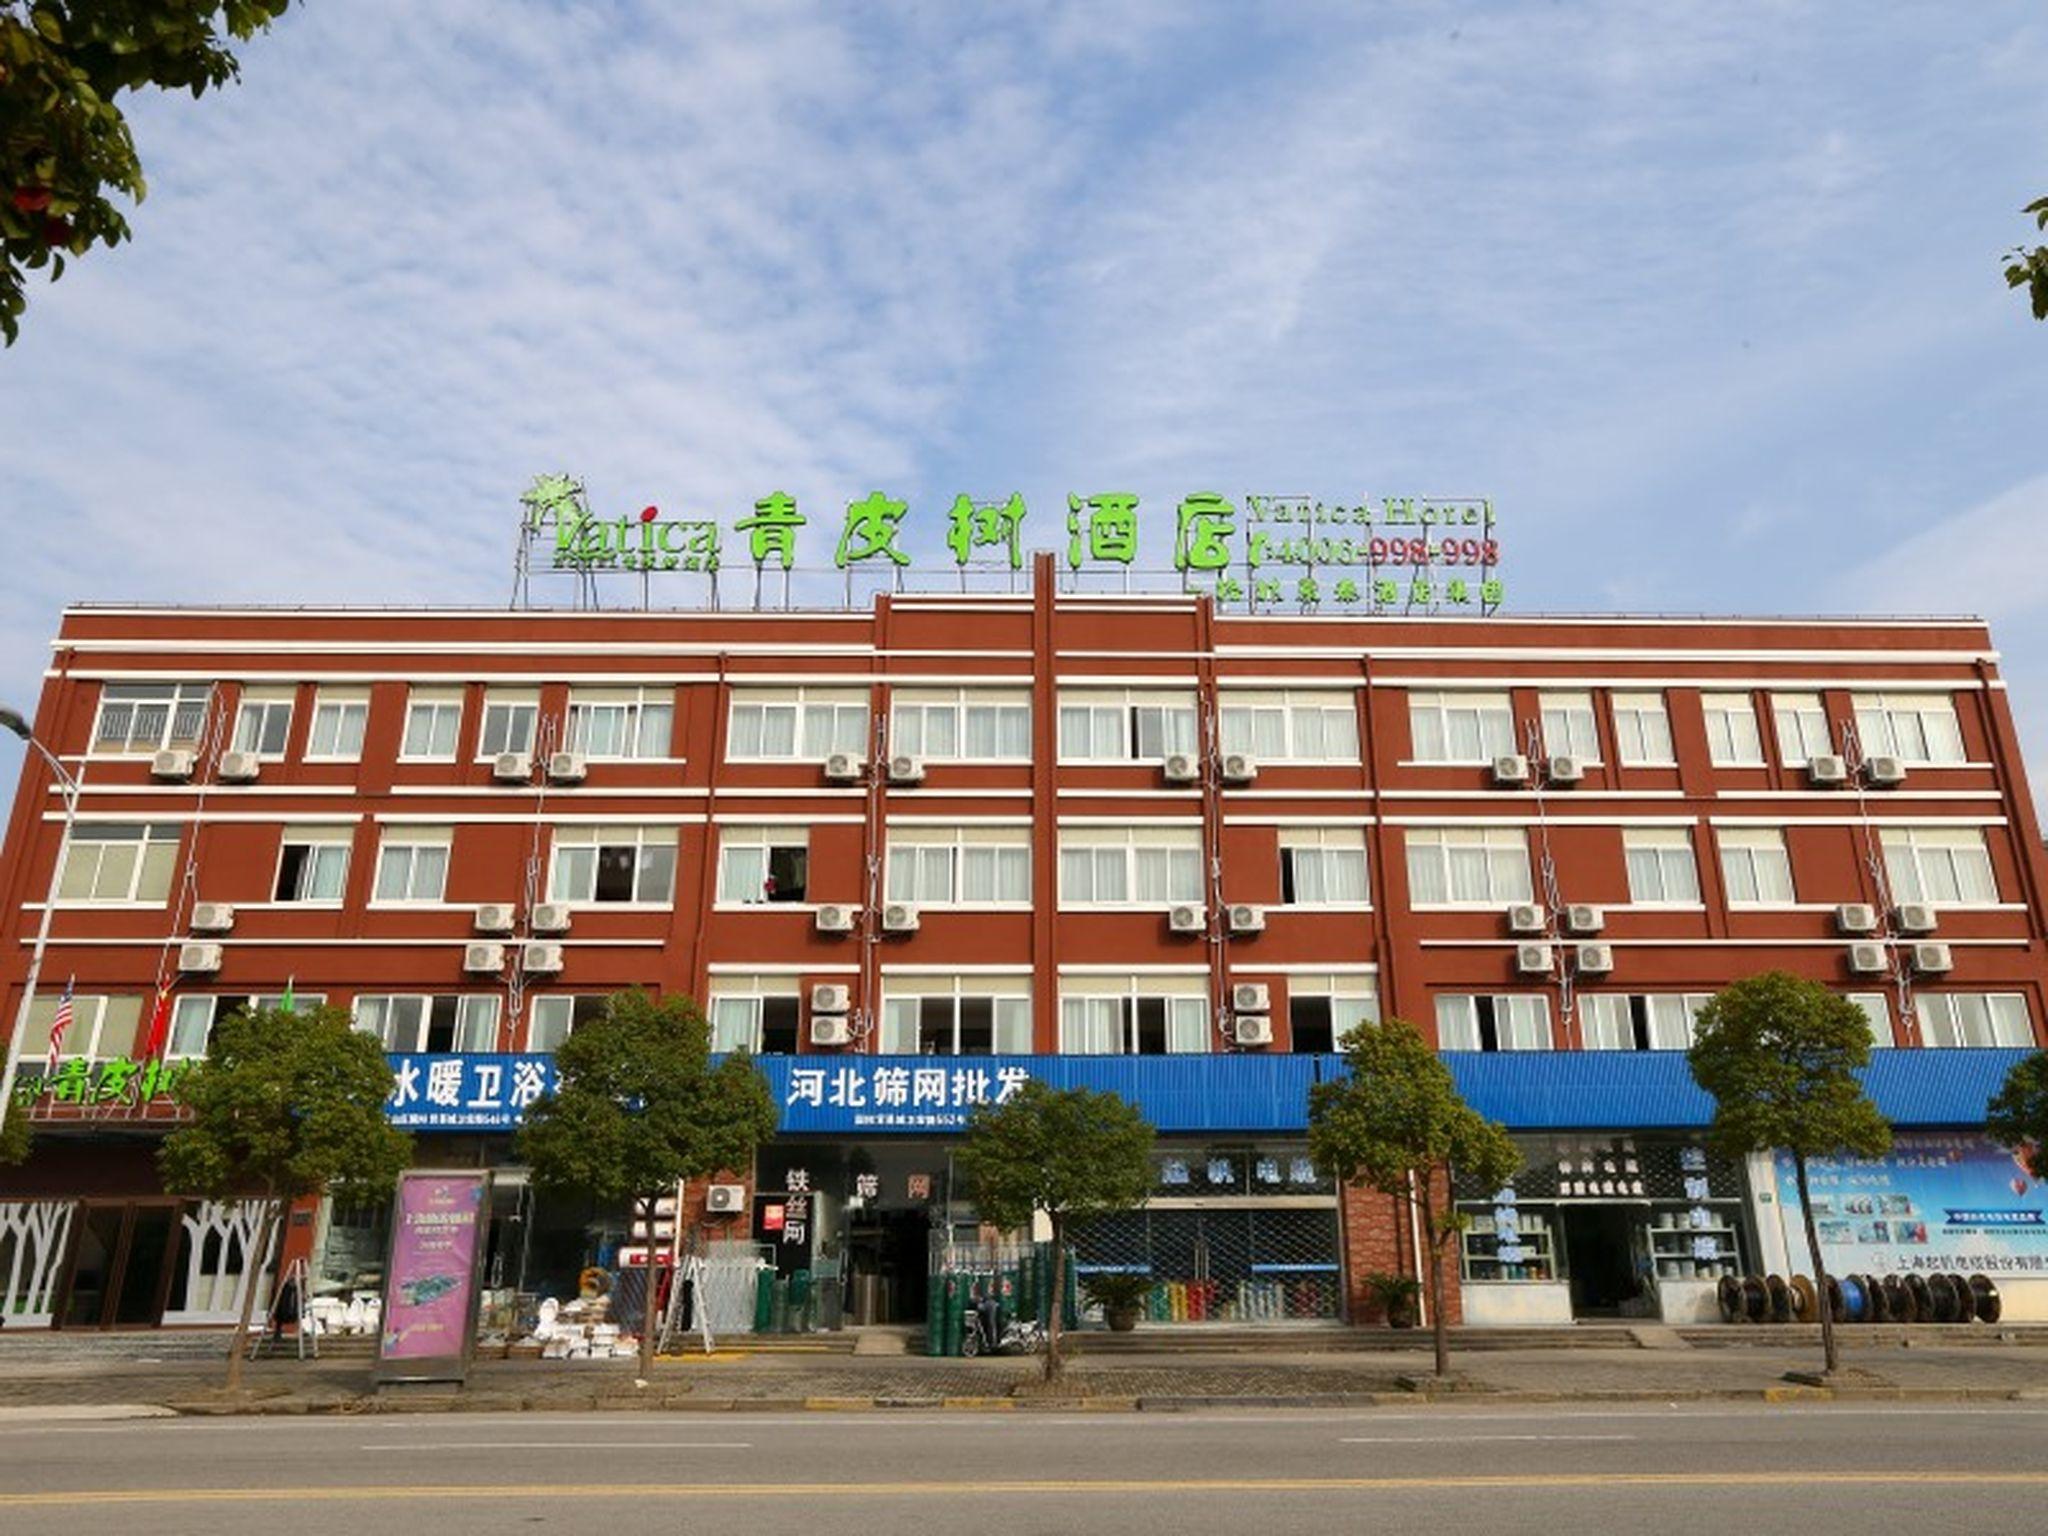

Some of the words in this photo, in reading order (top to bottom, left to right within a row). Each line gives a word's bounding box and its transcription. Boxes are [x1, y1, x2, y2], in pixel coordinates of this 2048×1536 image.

[553, 507, 721, 554] Vatica
[735, 490, 1236, 570] 青皮树酒店
[787, 1067, 1030, 1107] 河北筛网批发
[1897, 1253, 2048, 1271] 上海起帆电缆股份有限
